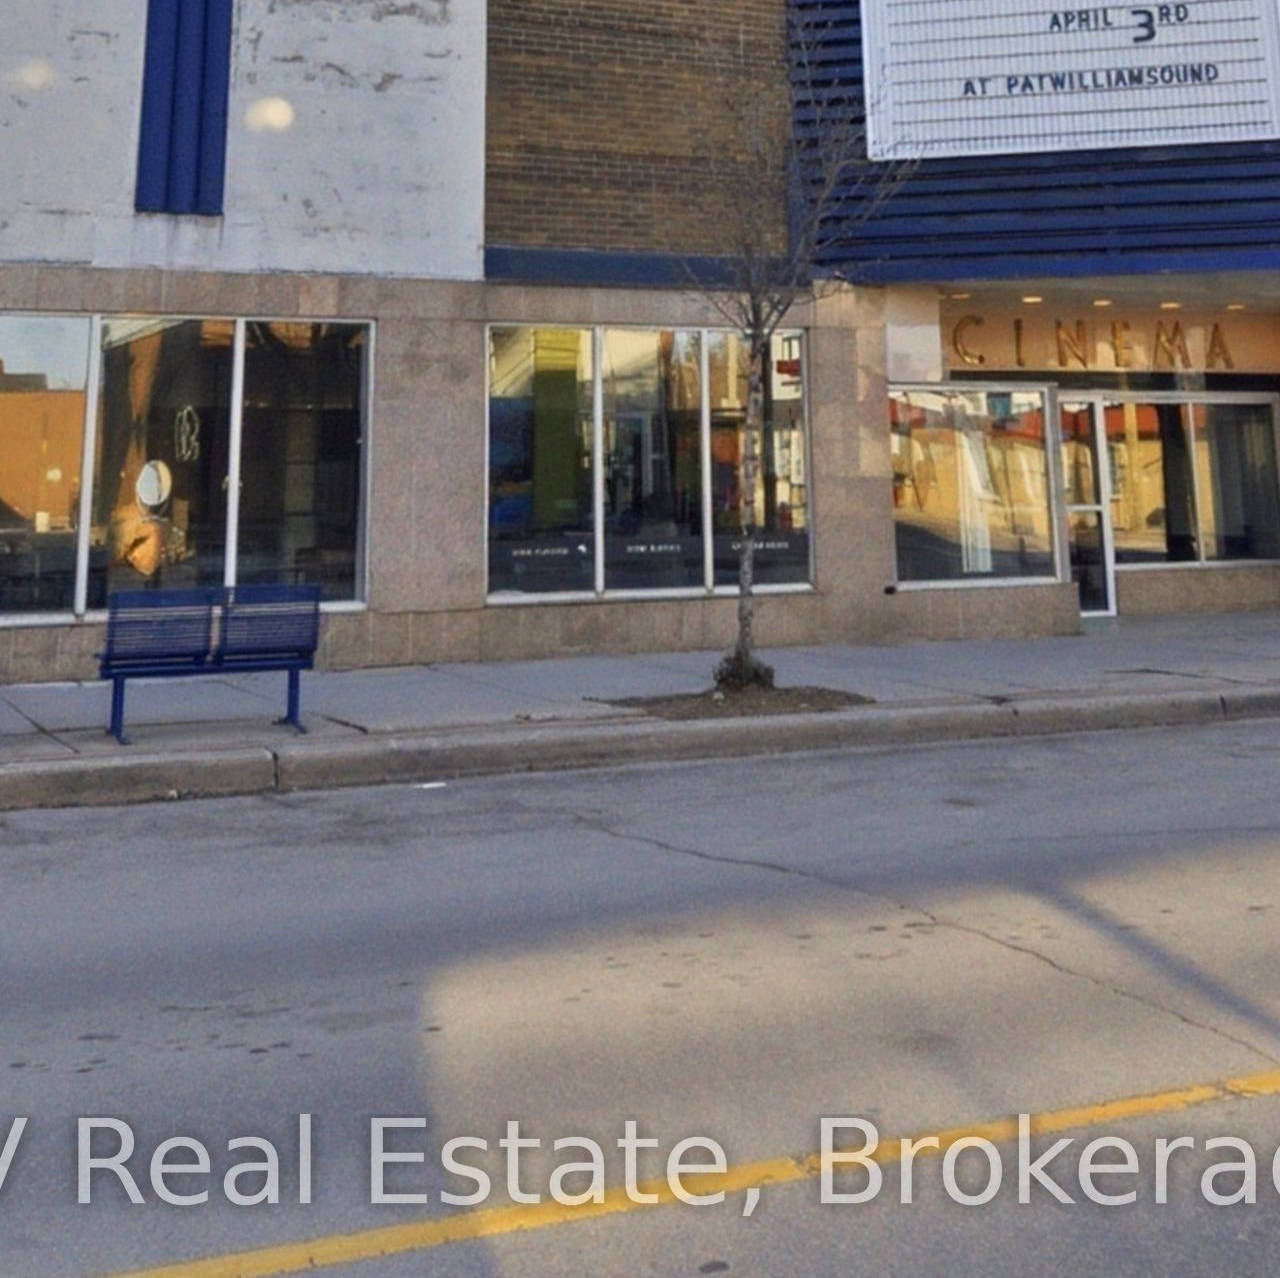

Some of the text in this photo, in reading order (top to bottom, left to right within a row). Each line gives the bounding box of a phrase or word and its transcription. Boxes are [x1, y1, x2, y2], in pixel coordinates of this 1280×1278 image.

[1050, 3, 1189, 43] APRIL 3RD
[963, 76, 990, 96] AT
[952, 314, 1235, 369] CINEMA
